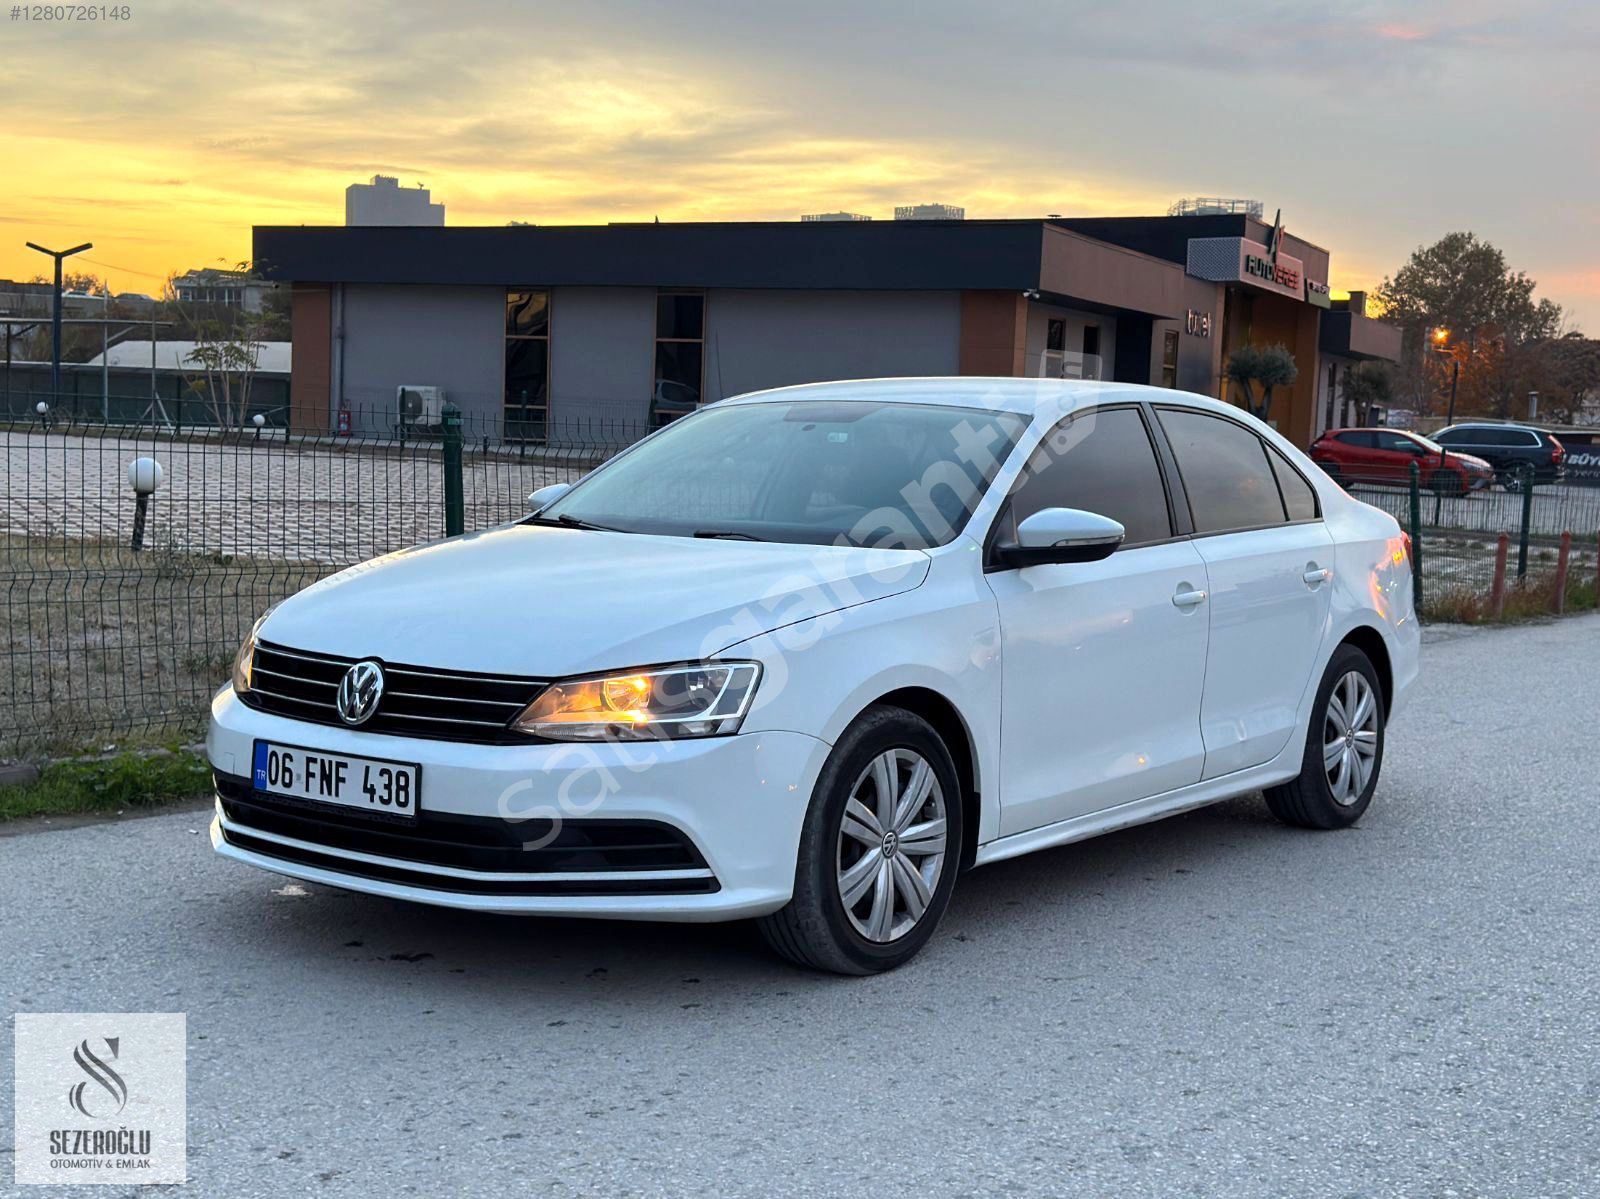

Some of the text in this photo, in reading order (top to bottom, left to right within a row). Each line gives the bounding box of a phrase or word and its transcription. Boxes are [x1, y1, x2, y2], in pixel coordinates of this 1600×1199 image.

[256, 768, 267, 782] TR
[268, 750, 410, 809] 06 FNF 438
